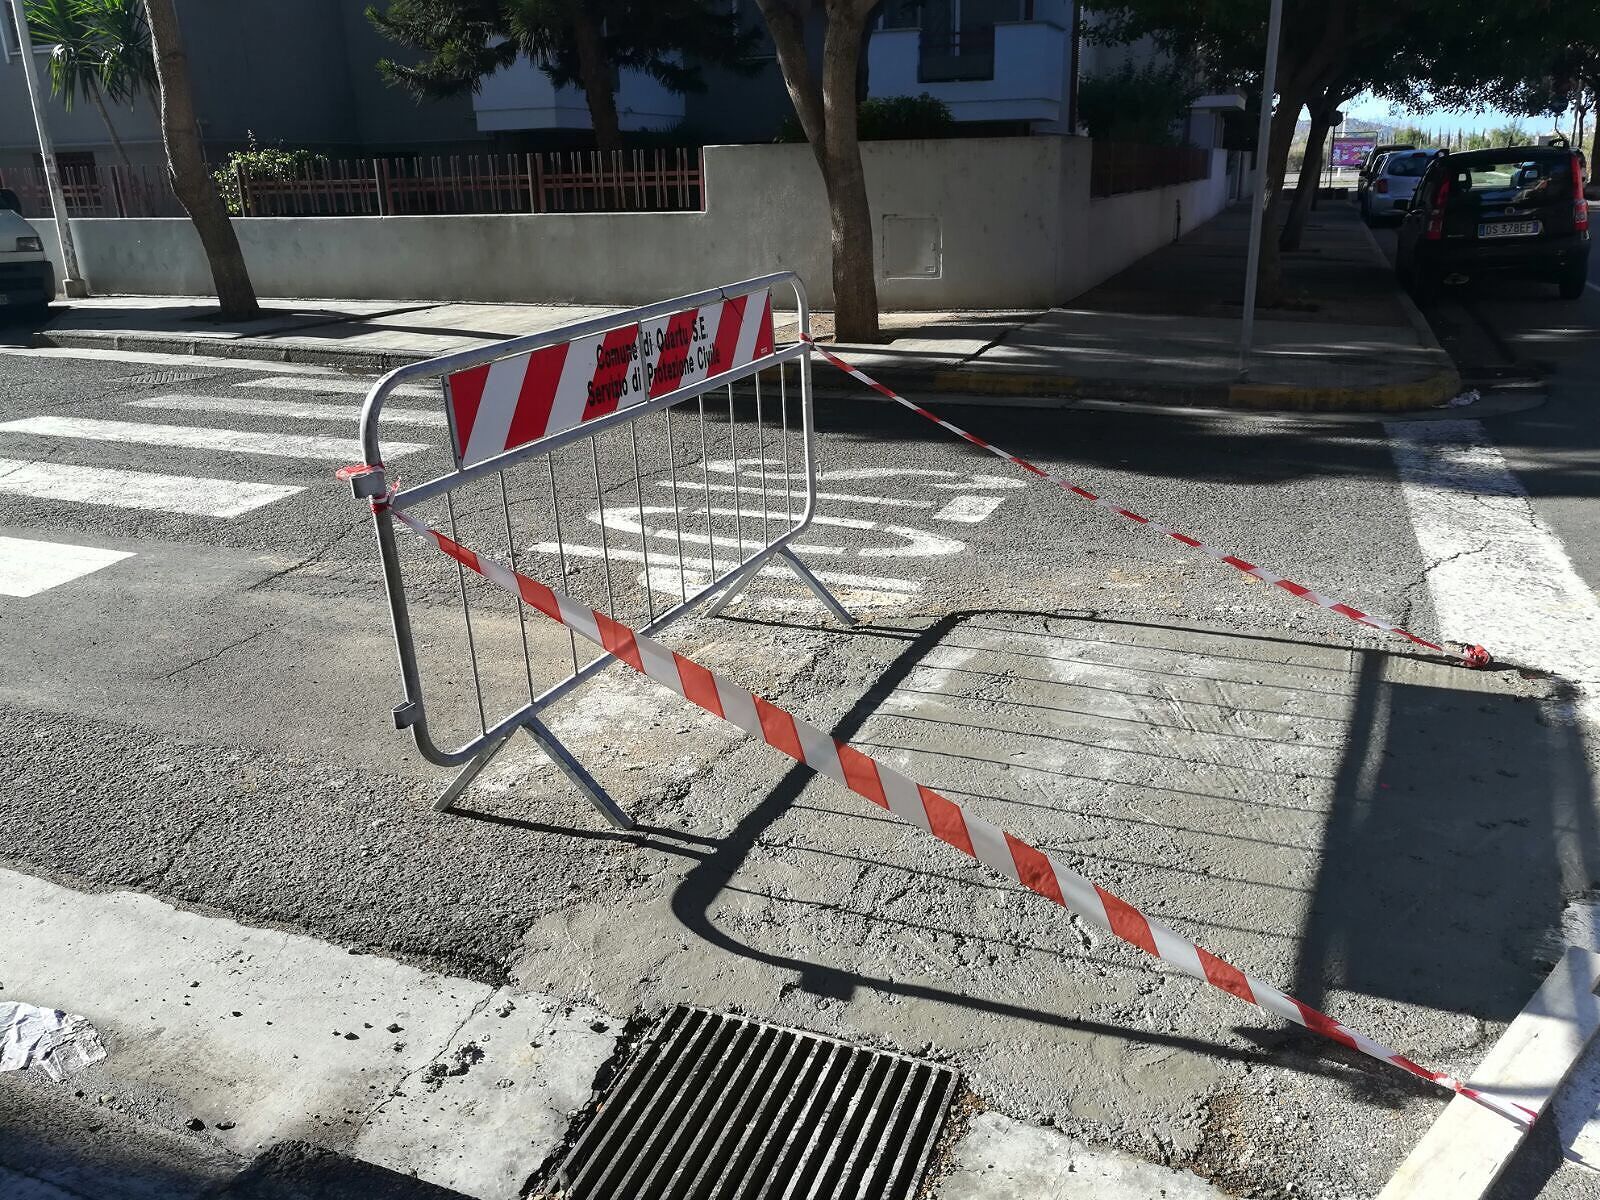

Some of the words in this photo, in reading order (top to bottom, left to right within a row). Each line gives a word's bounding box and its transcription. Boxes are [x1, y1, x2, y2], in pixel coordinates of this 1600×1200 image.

[1485, 224, 1498, 236] DS
[596, 341, 639, 370] Comune
[643, 331, 654, 357] di
[656, 327, 690, 349] Quartu
[692, 316, 709, 342] S.E.
[587, 377, 628, 406] Servizio
[632, 367, 642, 392] di
[647, 358, 695, 387] Protezione
[697, 342, 721, 370] Civile
